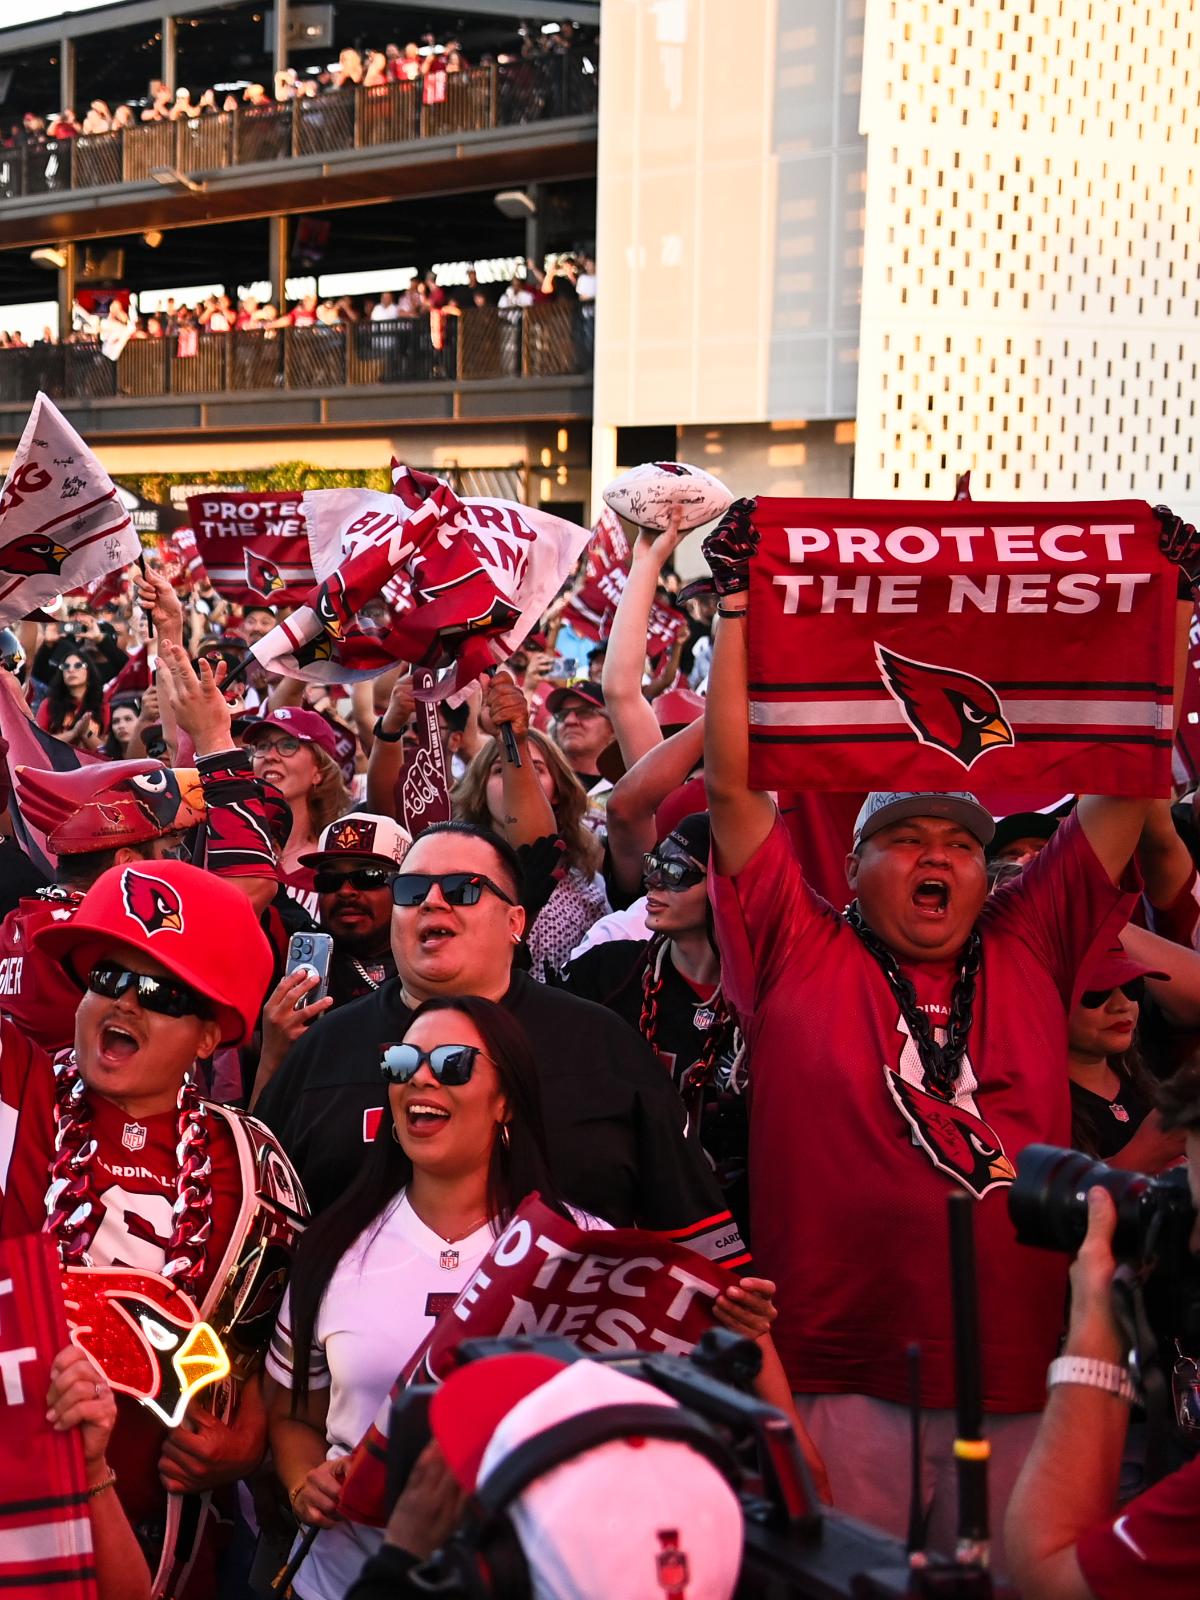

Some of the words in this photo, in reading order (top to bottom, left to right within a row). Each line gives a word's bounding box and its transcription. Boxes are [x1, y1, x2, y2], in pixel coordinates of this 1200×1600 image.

[200, 521, 257, 538] THE
[264, 519, 308, 537] NE
[202, 501, 308, 520] PROTE
[783, 524, 1135, 563] PROTECT
[772, 575, 922, 614] THE
[947, 573, 1151, 614] NEST
[490, 1216, 721, 1322] OTECT
